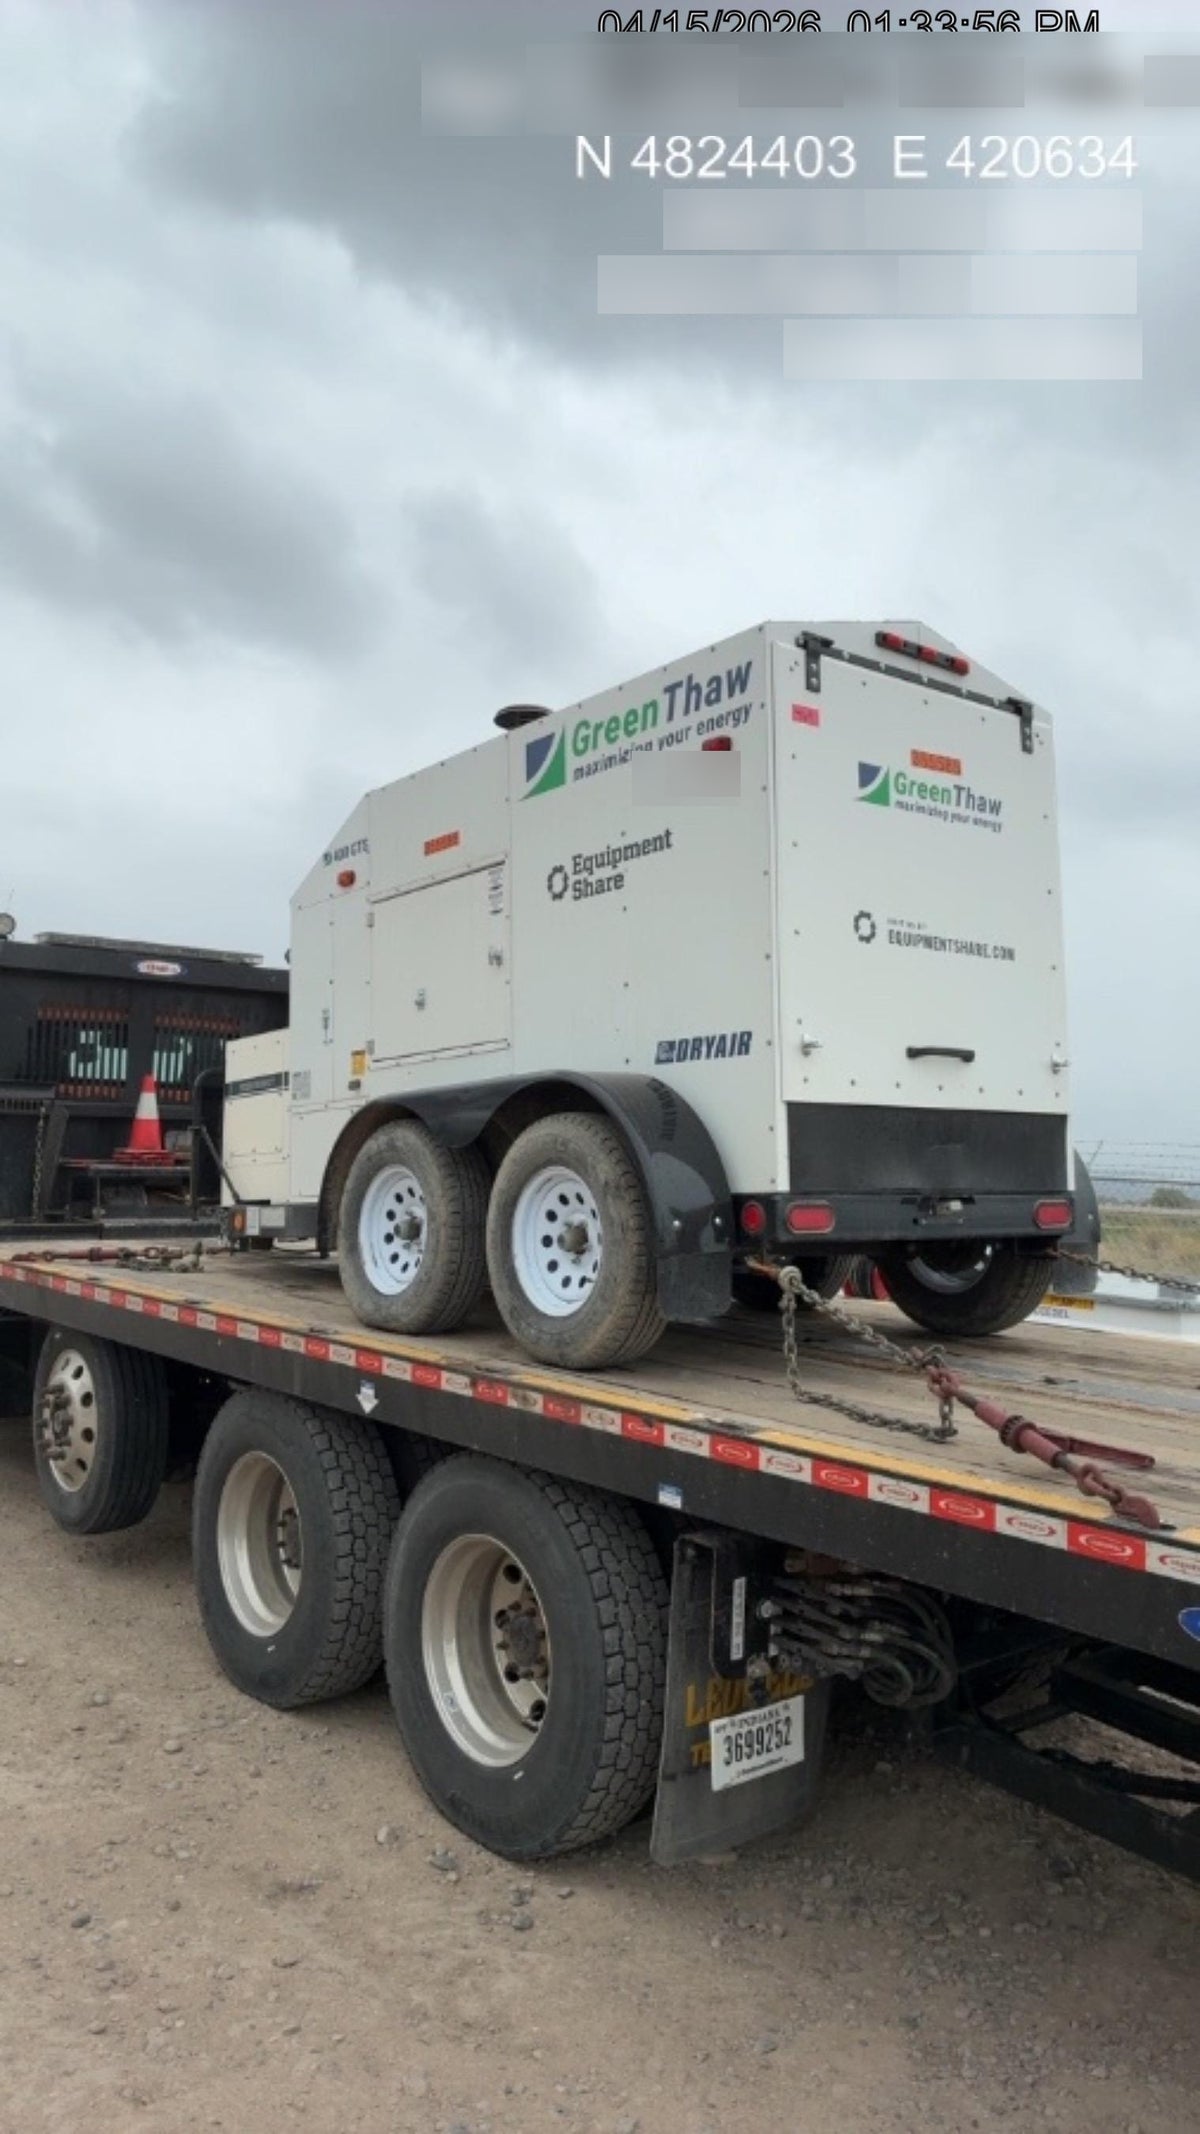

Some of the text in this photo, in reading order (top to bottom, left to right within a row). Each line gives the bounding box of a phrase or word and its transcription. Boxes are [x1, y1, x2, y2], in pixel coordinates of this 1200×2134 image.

[571, 660, 753, 757] GreenThaw
[658, 724, 692, 751] your
[696, 702, 752, 735] energy
[893, 770, 1002, 816] GreenThaw
[894, 799, 949, 822] maximizing
[571, 828, 673, 876] Equipment
[572, 872, 625, 901] Share
[888, 929, 1016, 962] EQUIPMENTSHARE.COM
[675, 1031, 753, 1063] DRYAIR
[722, 1715, 793, 1768] 3699252
